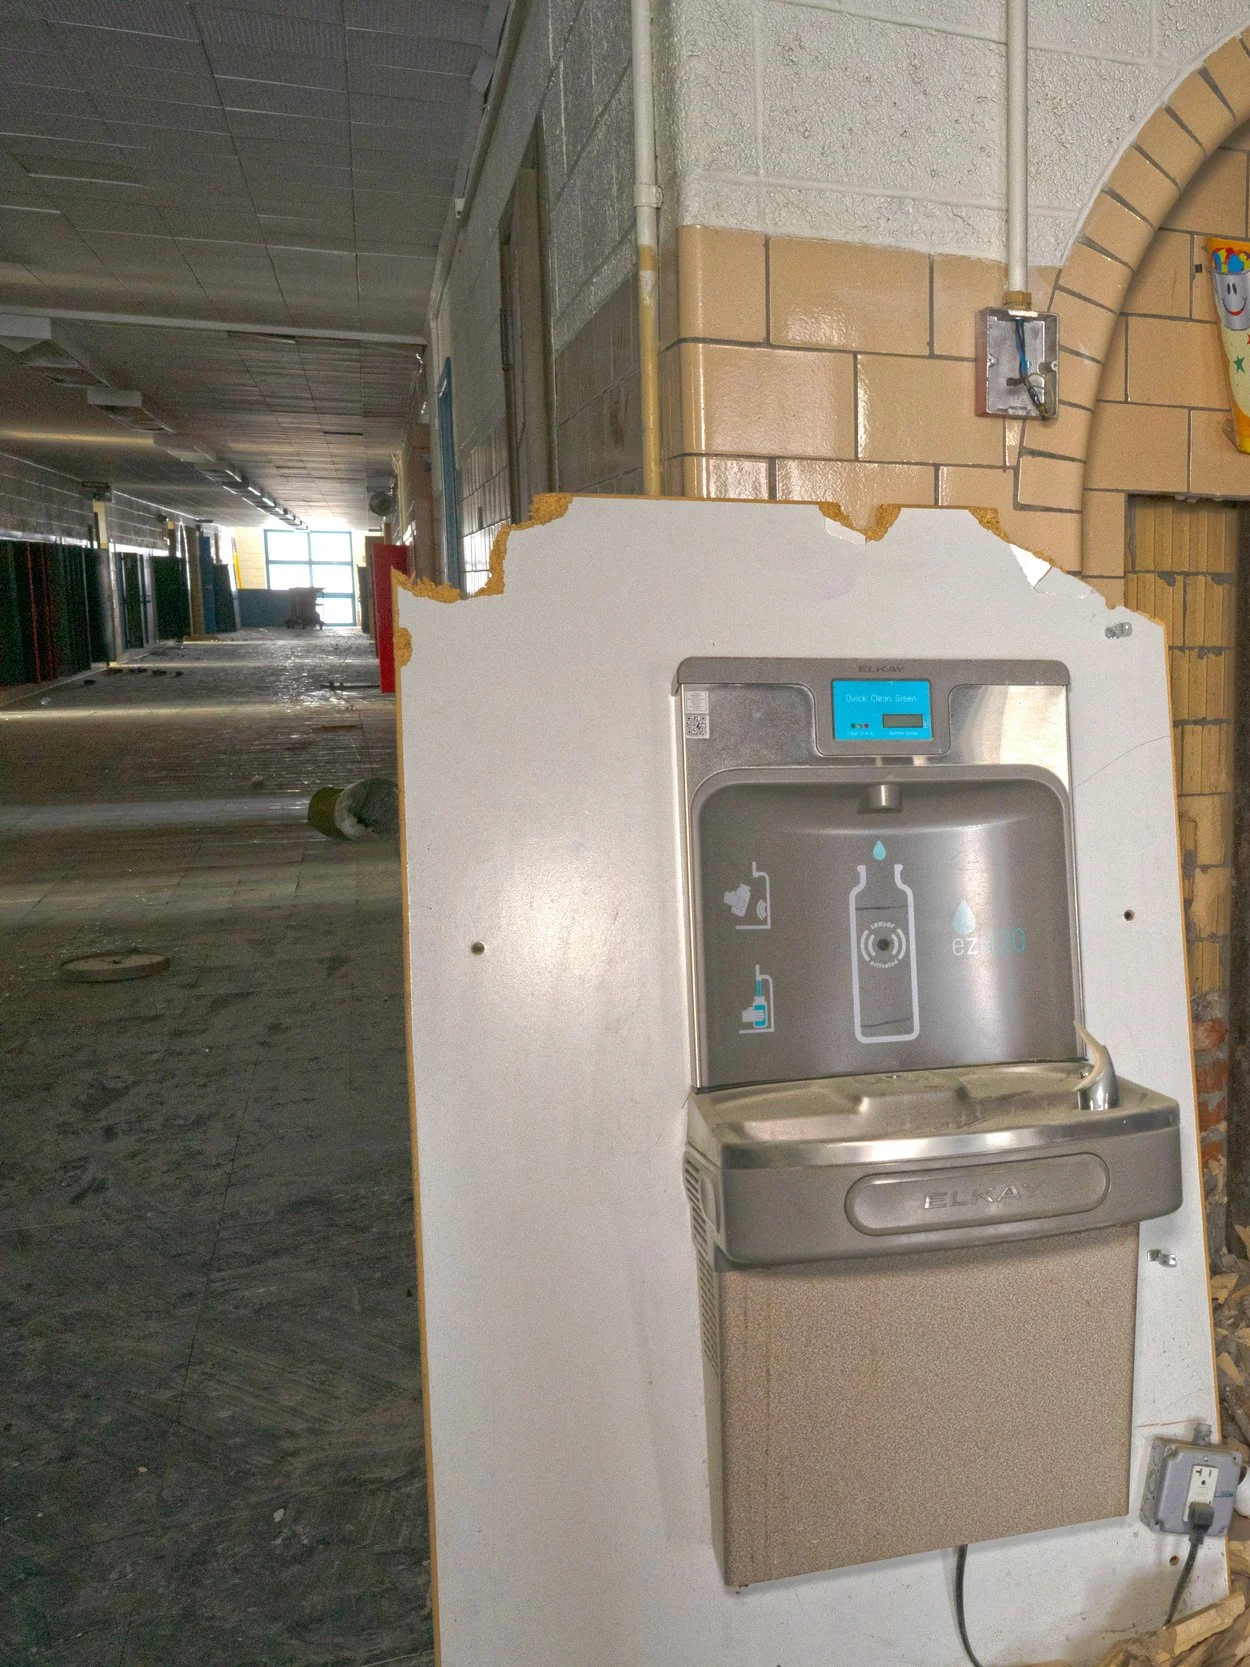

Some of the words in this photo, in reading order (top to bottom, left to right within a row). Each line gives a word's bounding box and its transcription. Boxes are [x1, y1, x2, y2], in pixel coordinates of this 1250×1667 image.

[858, 665, 904, 673] ELKAY
[870, 921, 896, 930] sensor
[923, 1183, 1040, 1209] ELKAY
